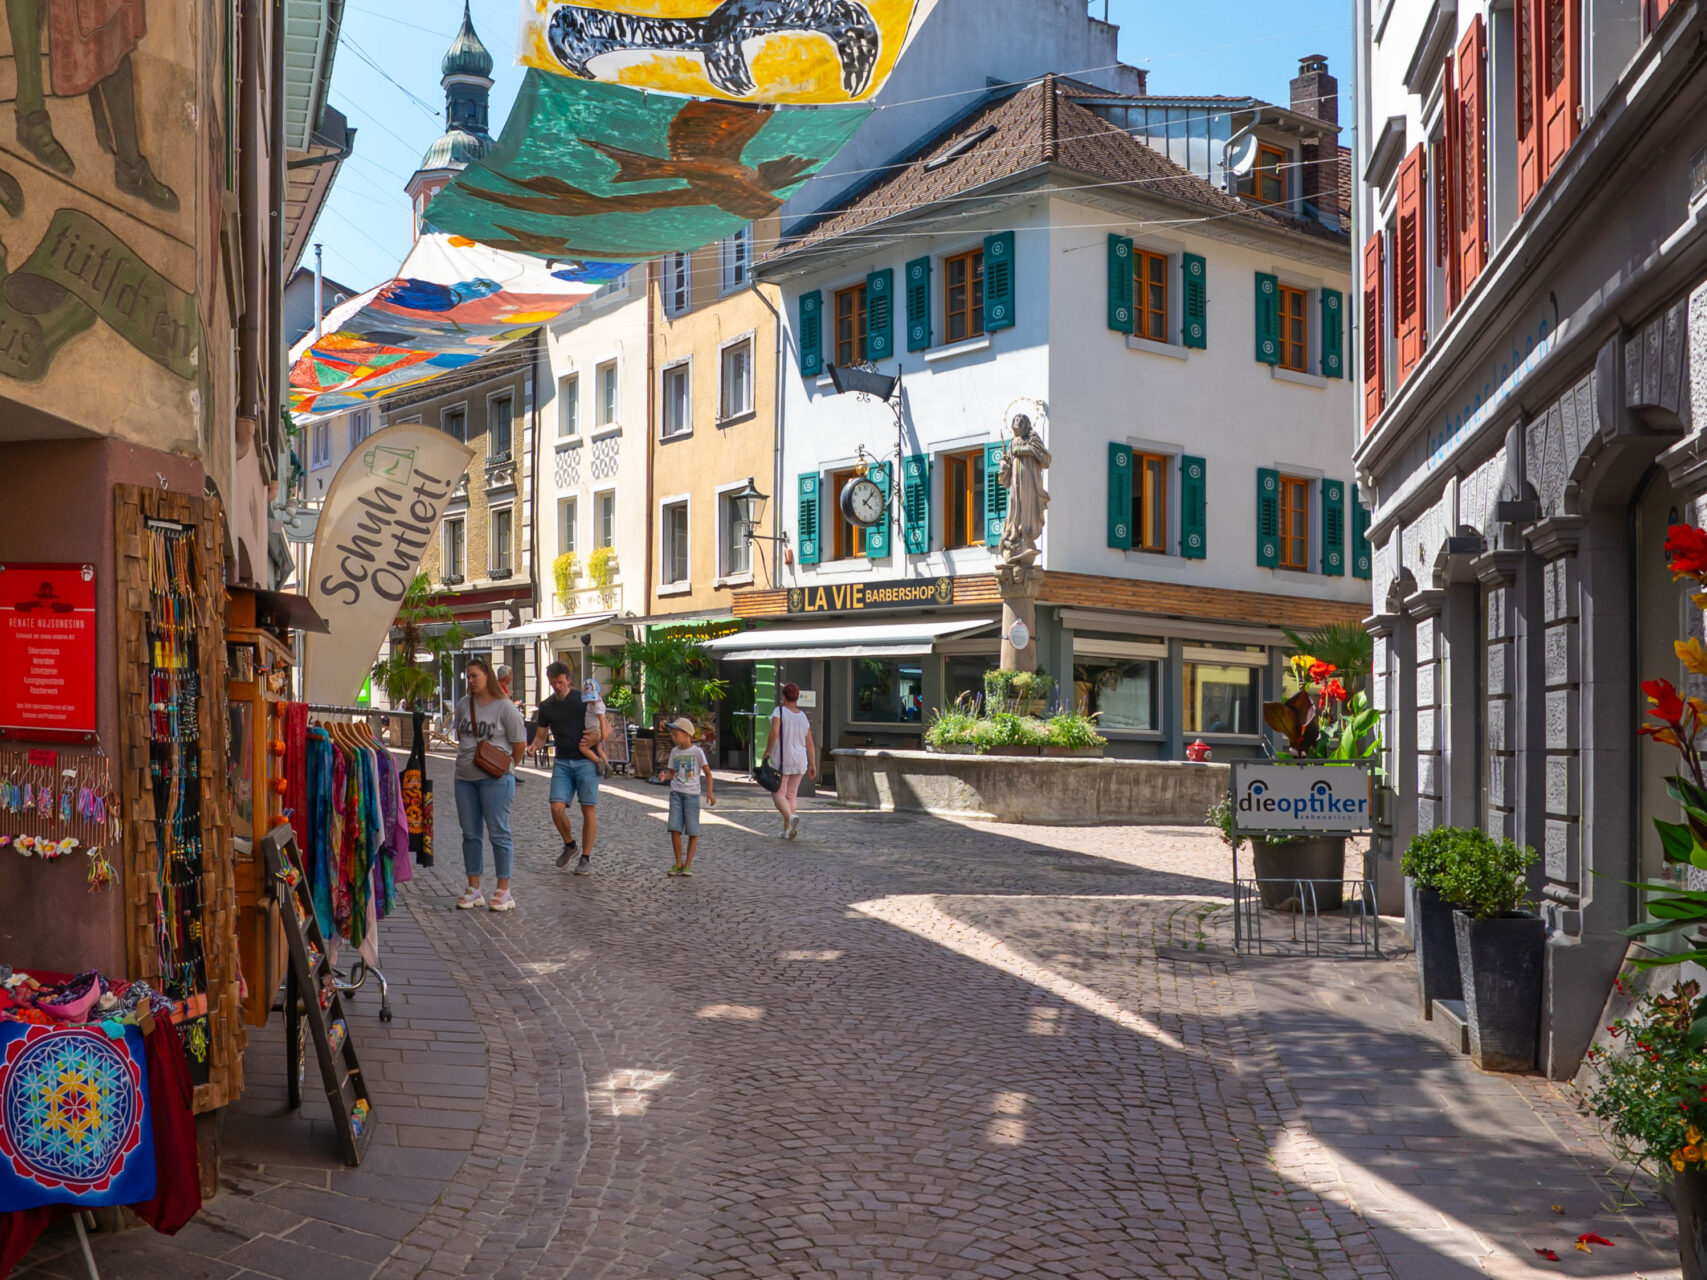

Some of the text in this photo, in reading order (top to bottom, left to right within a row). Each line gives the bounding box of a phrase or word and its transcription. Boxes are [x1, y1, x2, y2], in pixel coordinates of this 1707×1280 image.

[320, 486, 403, 606] Schuh
[370, 468, 452, 602] Outlet!
[804, 586, 828, 612] LA
[832, 583, 864, 610] VIE
[865, 585, 935, 603] BARBERSHOP
[8, 617, 35, 629] RENATE
[1238, 786, 1368, 820] dieoptiker
